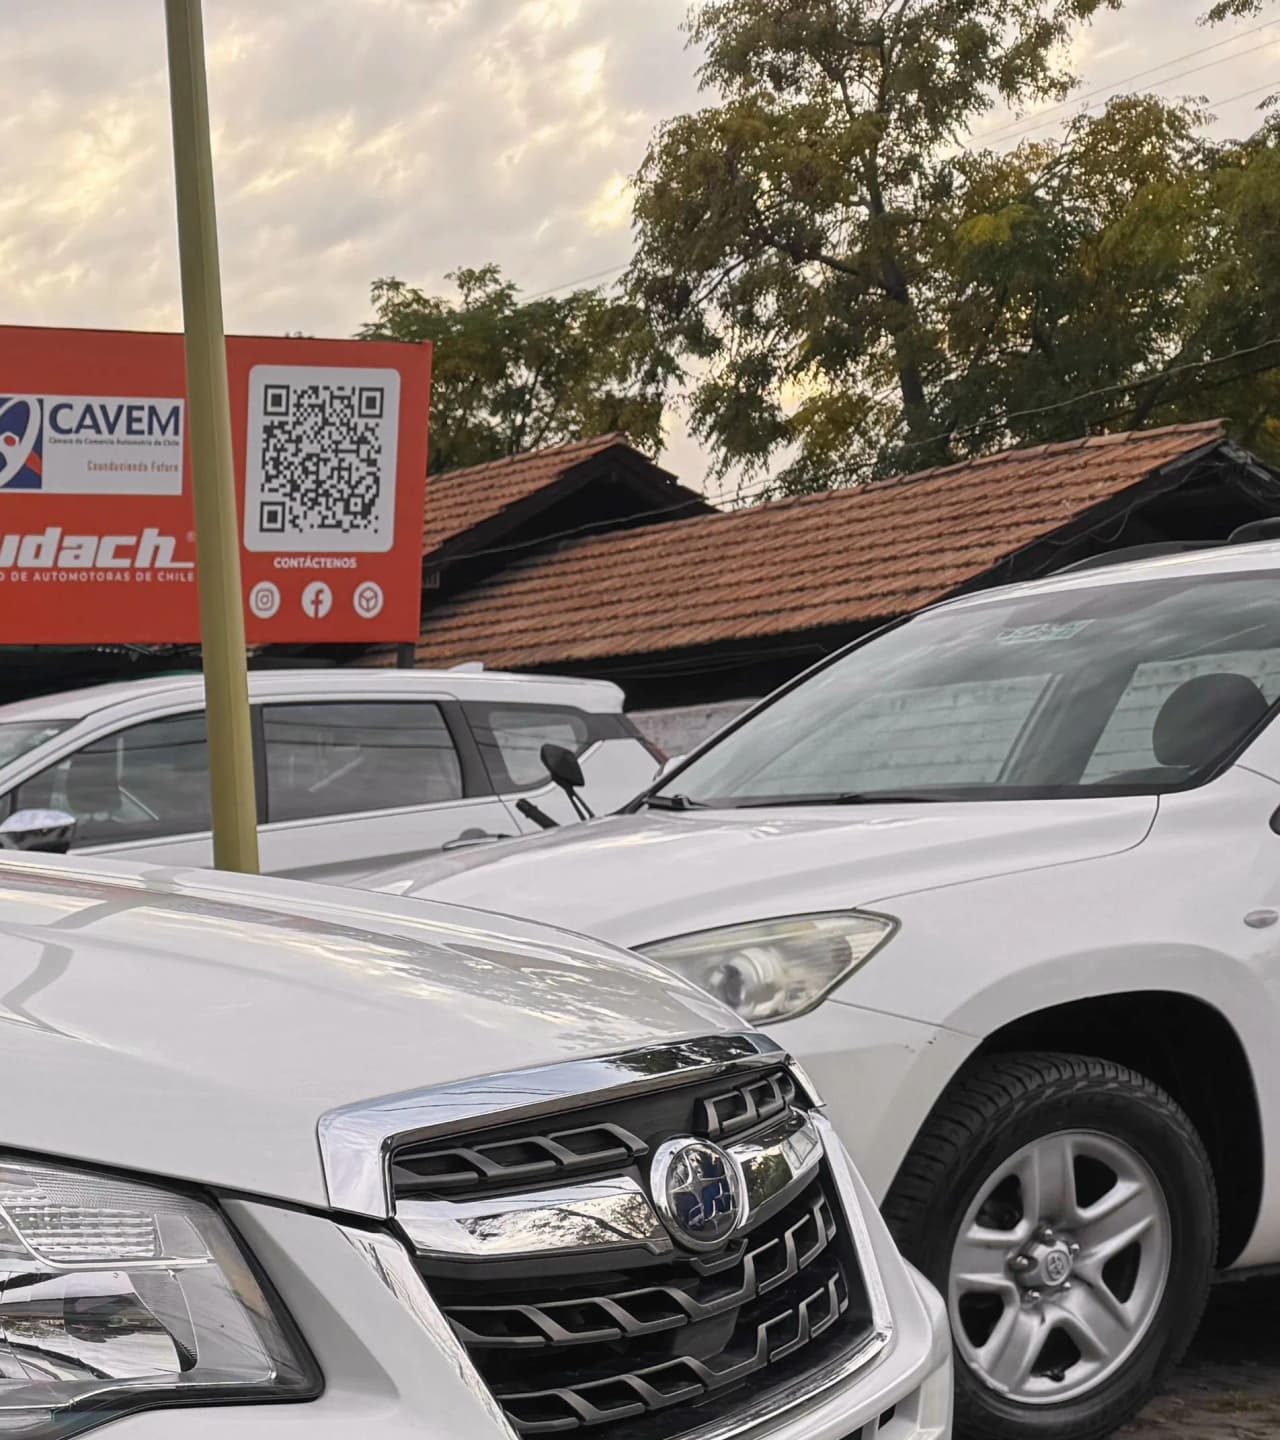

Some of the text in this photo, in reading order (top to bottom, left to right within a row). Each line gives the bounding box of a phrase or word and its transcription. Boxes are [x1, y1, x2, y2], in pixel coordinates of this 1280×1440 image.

[48, 402, 181, 437] CAVEM
[273, 554, 358, 569] CONTÁCTENOS
[10, 571, 28, 582] DE
[33, 571, 131, 582] AUTOMOTORAS
[135, 571, 152, 582] DE
[157, 571, 195, 582] CHILE
